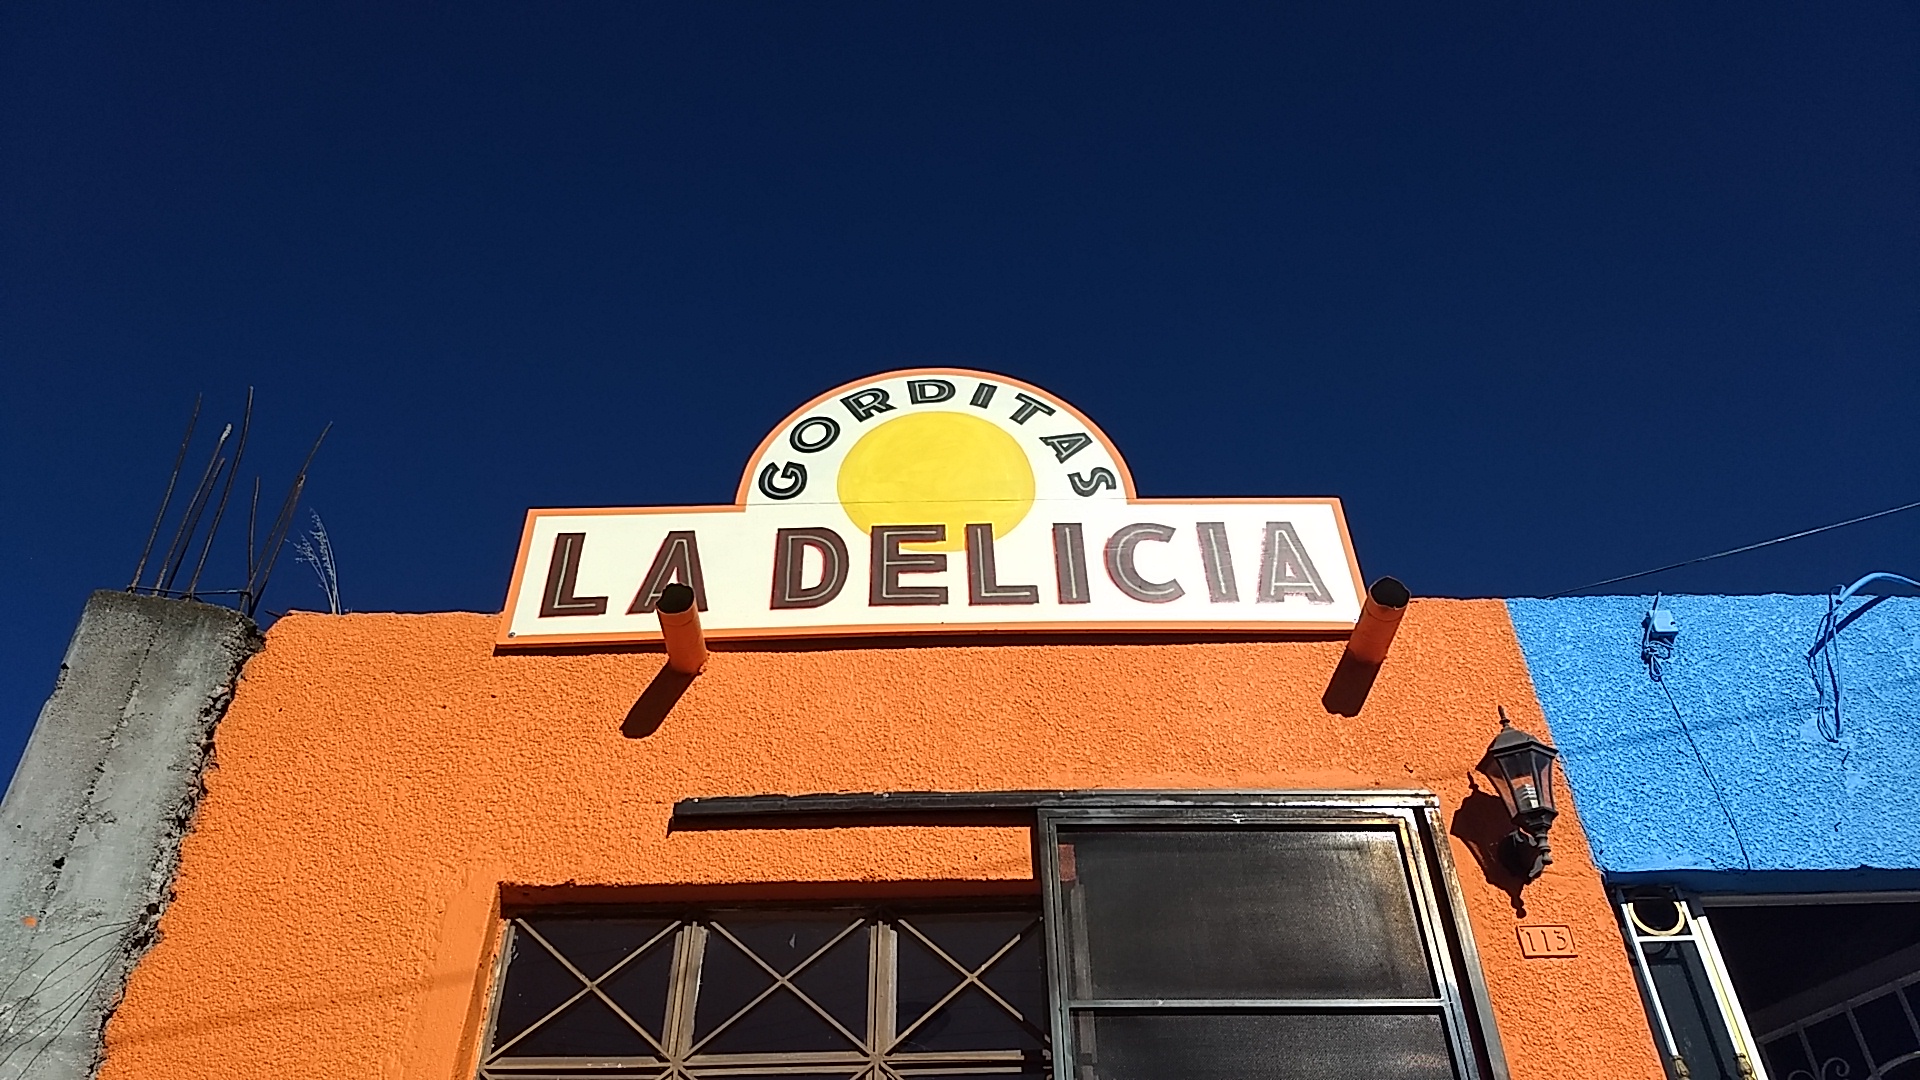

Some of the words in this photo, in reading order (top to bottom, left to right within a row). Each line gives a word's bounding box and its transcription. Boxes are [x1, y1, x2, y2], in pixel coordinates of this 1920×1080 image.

[758, 379, 1117, 498] GORDITAS
[538, 530, 709, 618] LA
[770, 522, 1335, 611] DELICIA
